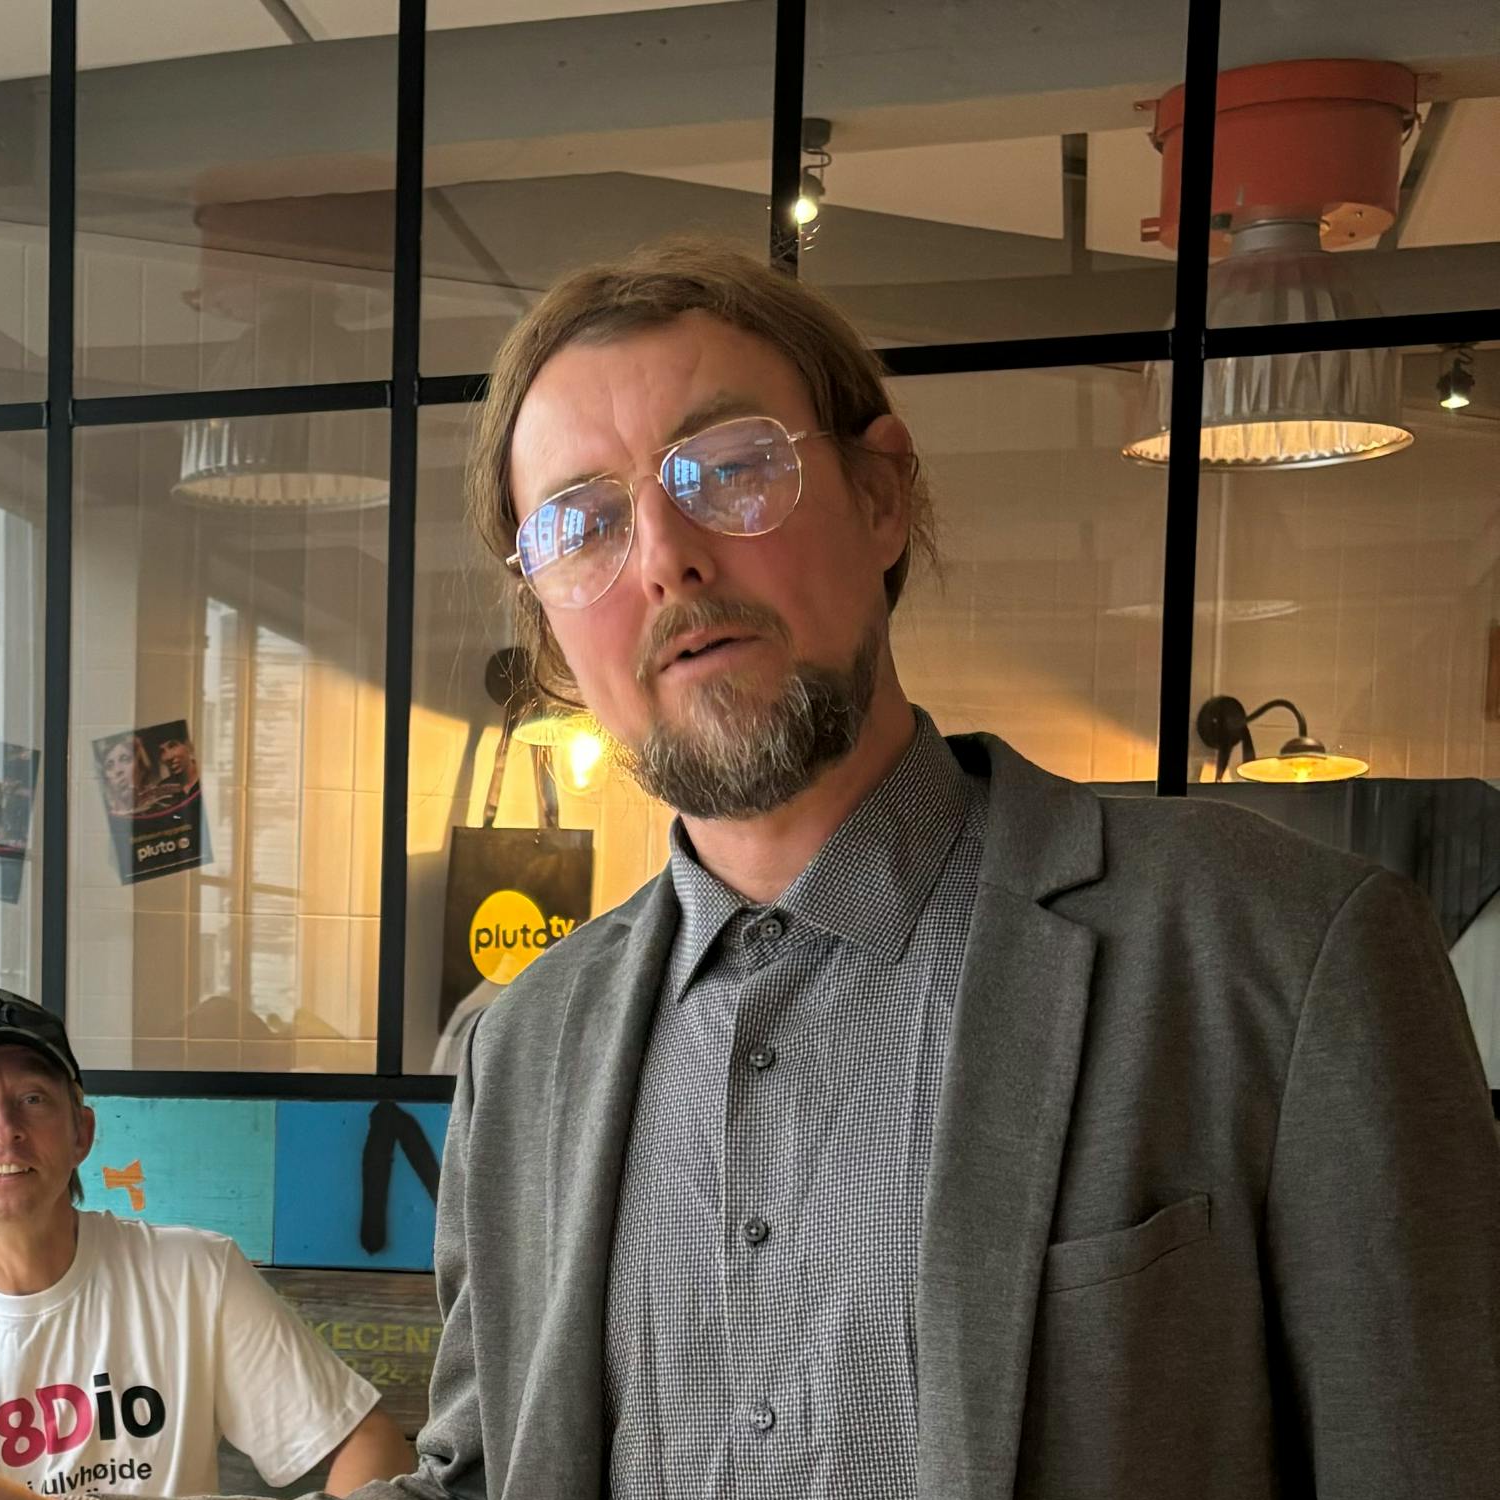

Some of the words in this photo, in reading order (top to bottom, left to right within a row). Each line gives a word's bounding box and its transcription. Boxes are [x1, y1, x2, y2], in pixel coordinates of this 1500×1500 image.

[137, 841, 177, 862] pluto
[474, 923, 550, 954] pluto
[41, 1458, 153, 1496] ulvhøjde
